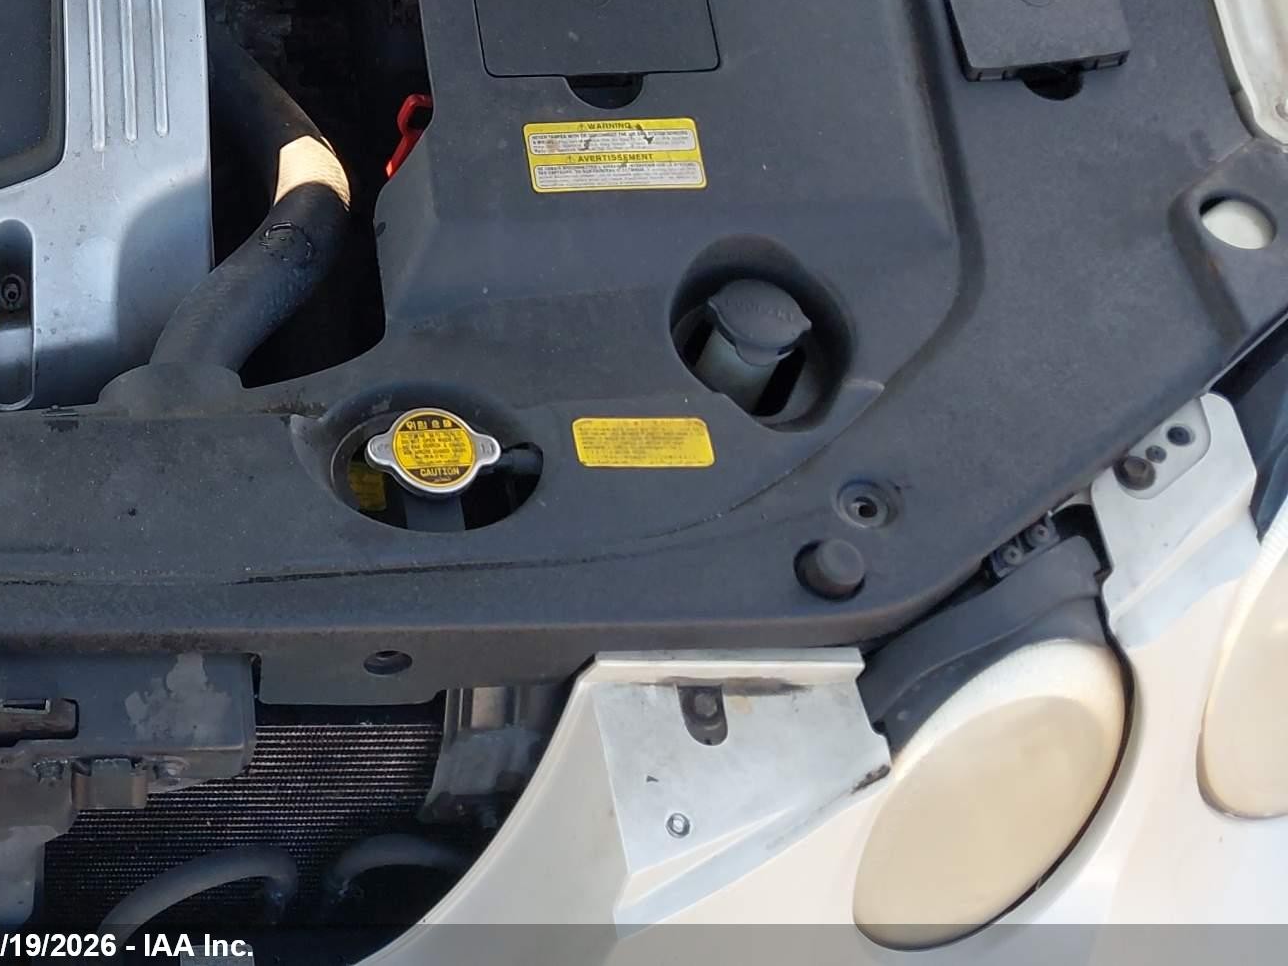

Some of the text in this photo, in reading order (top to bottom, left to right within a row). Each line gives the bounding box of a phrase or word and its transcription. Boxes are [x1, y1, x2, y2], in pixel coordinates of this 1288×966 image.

[587, 122, 632, 130] WARNING
[577, 153, 654, 162] AVERTISSEMENT
[420, 466, 460, 477] CAUTION
